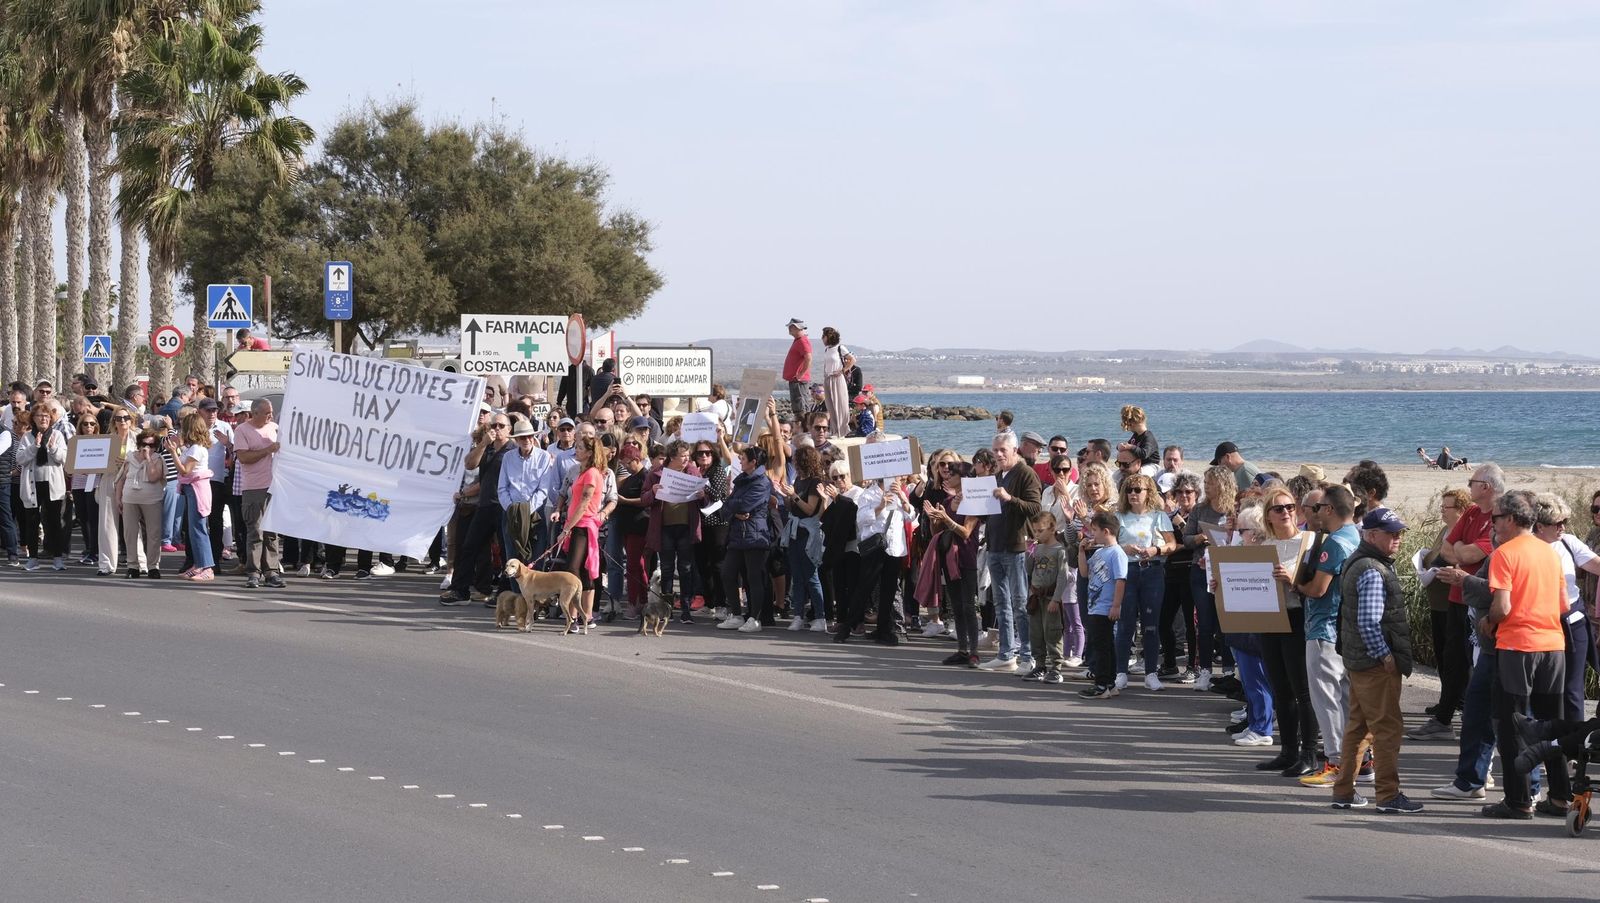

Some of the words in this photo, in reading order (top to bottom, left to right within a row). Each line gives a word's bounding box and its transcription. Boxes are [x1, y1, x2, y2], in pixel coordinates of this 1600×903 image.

[335, 297, 341, 305] 8
[485, 320, 565, 334] FARMACIA
[159, 336, 178, 347] 30
[463, 360, 565, 373] COSTACABANA
[636, 357, 674, 367] PROHIBIDO
[675, 357, 706, 367] APARCAR
[294, 350, 325, 380] SIN
[326, 354, 457, 401] SOLUCIONES
[636, 374, 674, 384] PROHIBIDO
[675, 374, 708, 384] ACAMPAR
[352, 391, 401, 423] HAY
